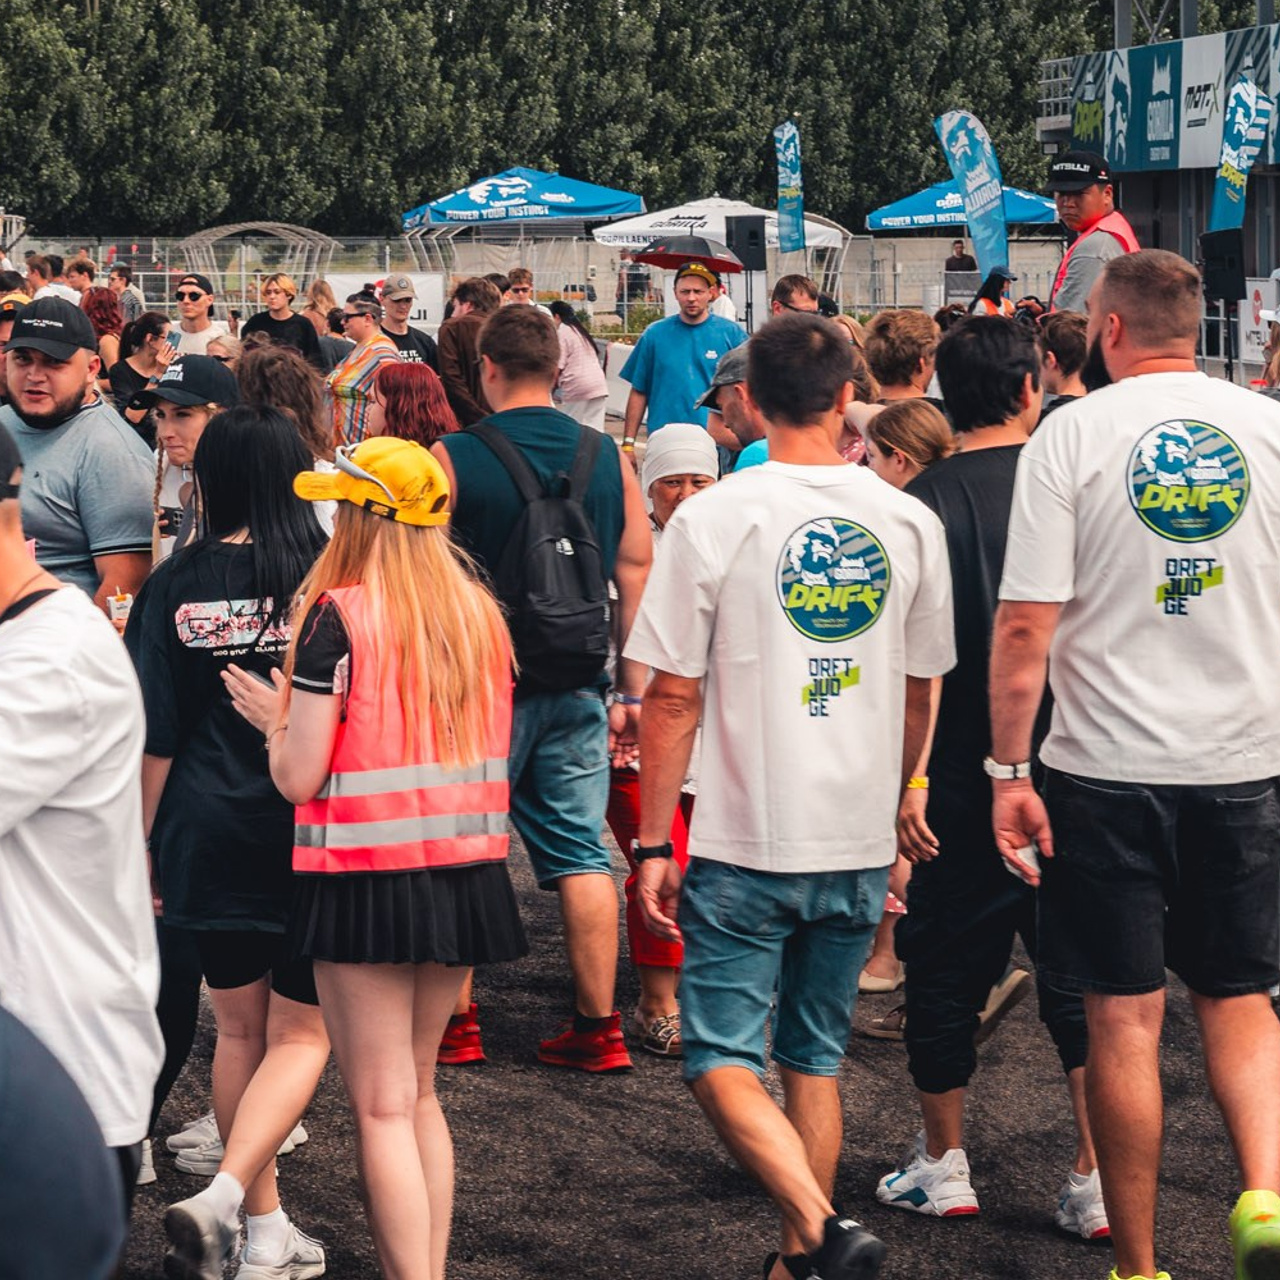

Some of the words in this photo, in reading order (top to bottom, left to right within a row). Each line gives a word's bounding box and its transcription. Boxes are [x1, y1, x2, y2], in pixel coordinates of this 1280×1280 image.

[446, 210, 479, 219] POWER
[481, 207, 506, 218] YOUR
[508, 205, 549, 216] INSTINCT
[881, 216, 911, 226] POWER
[912, 214, 935, 224] YOUR
[1139, 484, 1240, 513] DRIFT
[1165, 558, 1216, 577] DRFT
[1164, 578, 1203, 596] JUD
[787, 583, 881, 615] DRIFT
[1164, 597, 1188, 616] GE
[809, 658, 852, 677] DRFT
[809, 678, 841, 697] JUD
[809, 698, 829, 717] GE
